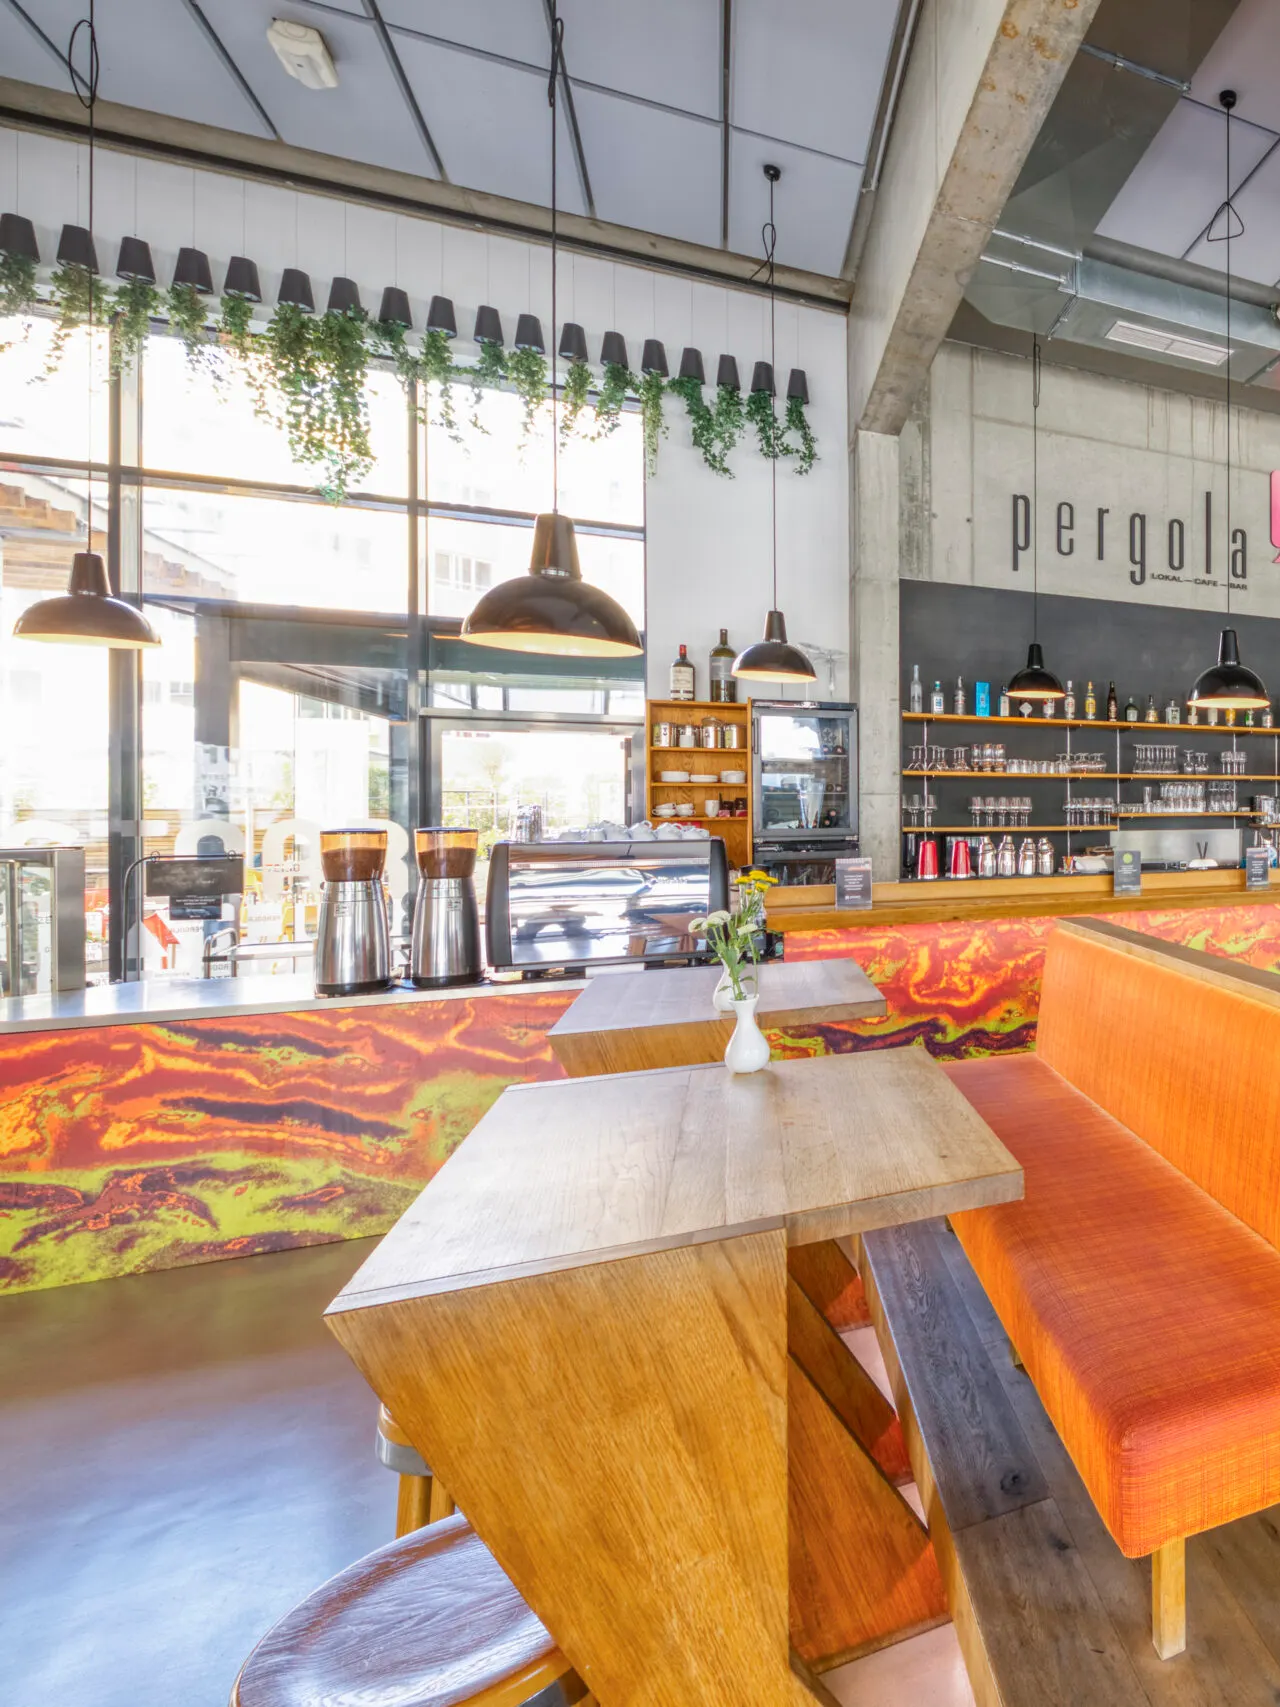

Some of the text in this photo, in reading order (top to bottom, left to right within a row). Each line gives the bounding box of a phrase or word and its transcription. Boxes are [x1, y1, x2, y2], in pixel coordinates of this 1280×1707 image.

[1012, 491, 1247, 586] pergola
[1151, 573, 1248, 590] LOKAL CAFE BAR
